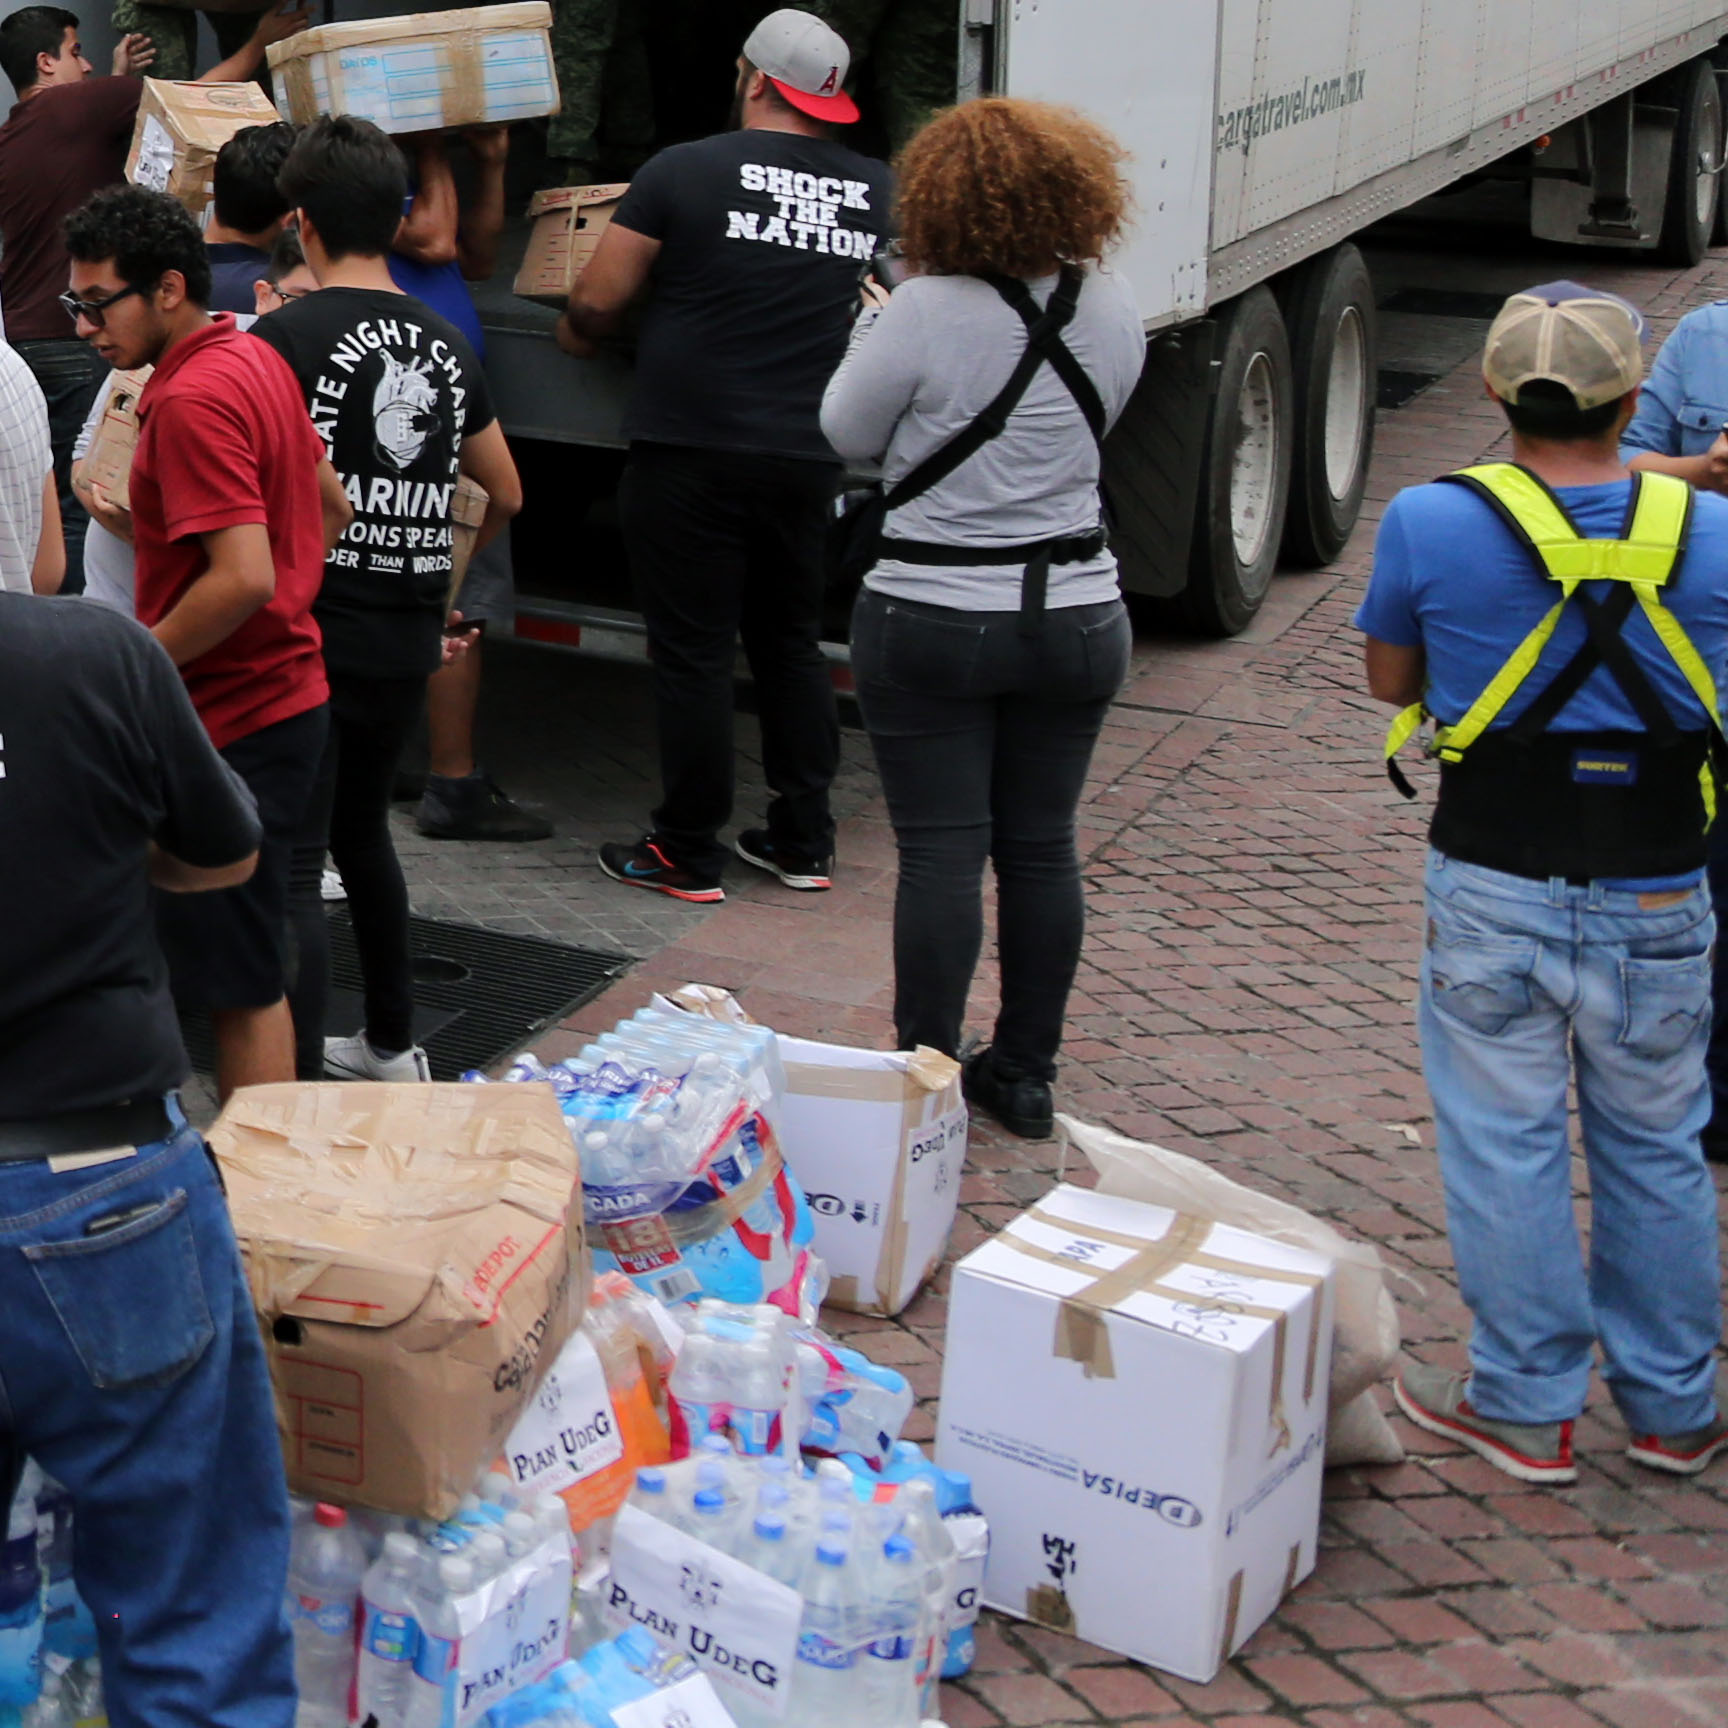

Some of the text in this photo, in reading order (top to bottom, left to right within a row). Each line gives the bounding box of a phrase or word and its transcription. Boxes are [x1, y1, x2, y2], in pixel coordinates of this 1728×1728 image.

[740, 163, 871, 210] SHOCK
[773, 194, 839, 227] THE
[725, 210, 878, 260] NATION
[330, 319, 422, 374] NIGHT
[370, 553, 404, 569] THAN
[413, 555, 453, 574] WORDS
[607, 1220, 662, 1252] 18
[513, 1445, 558, 1483] PLAN
[609, 1582, 679, 1640] PLAN
